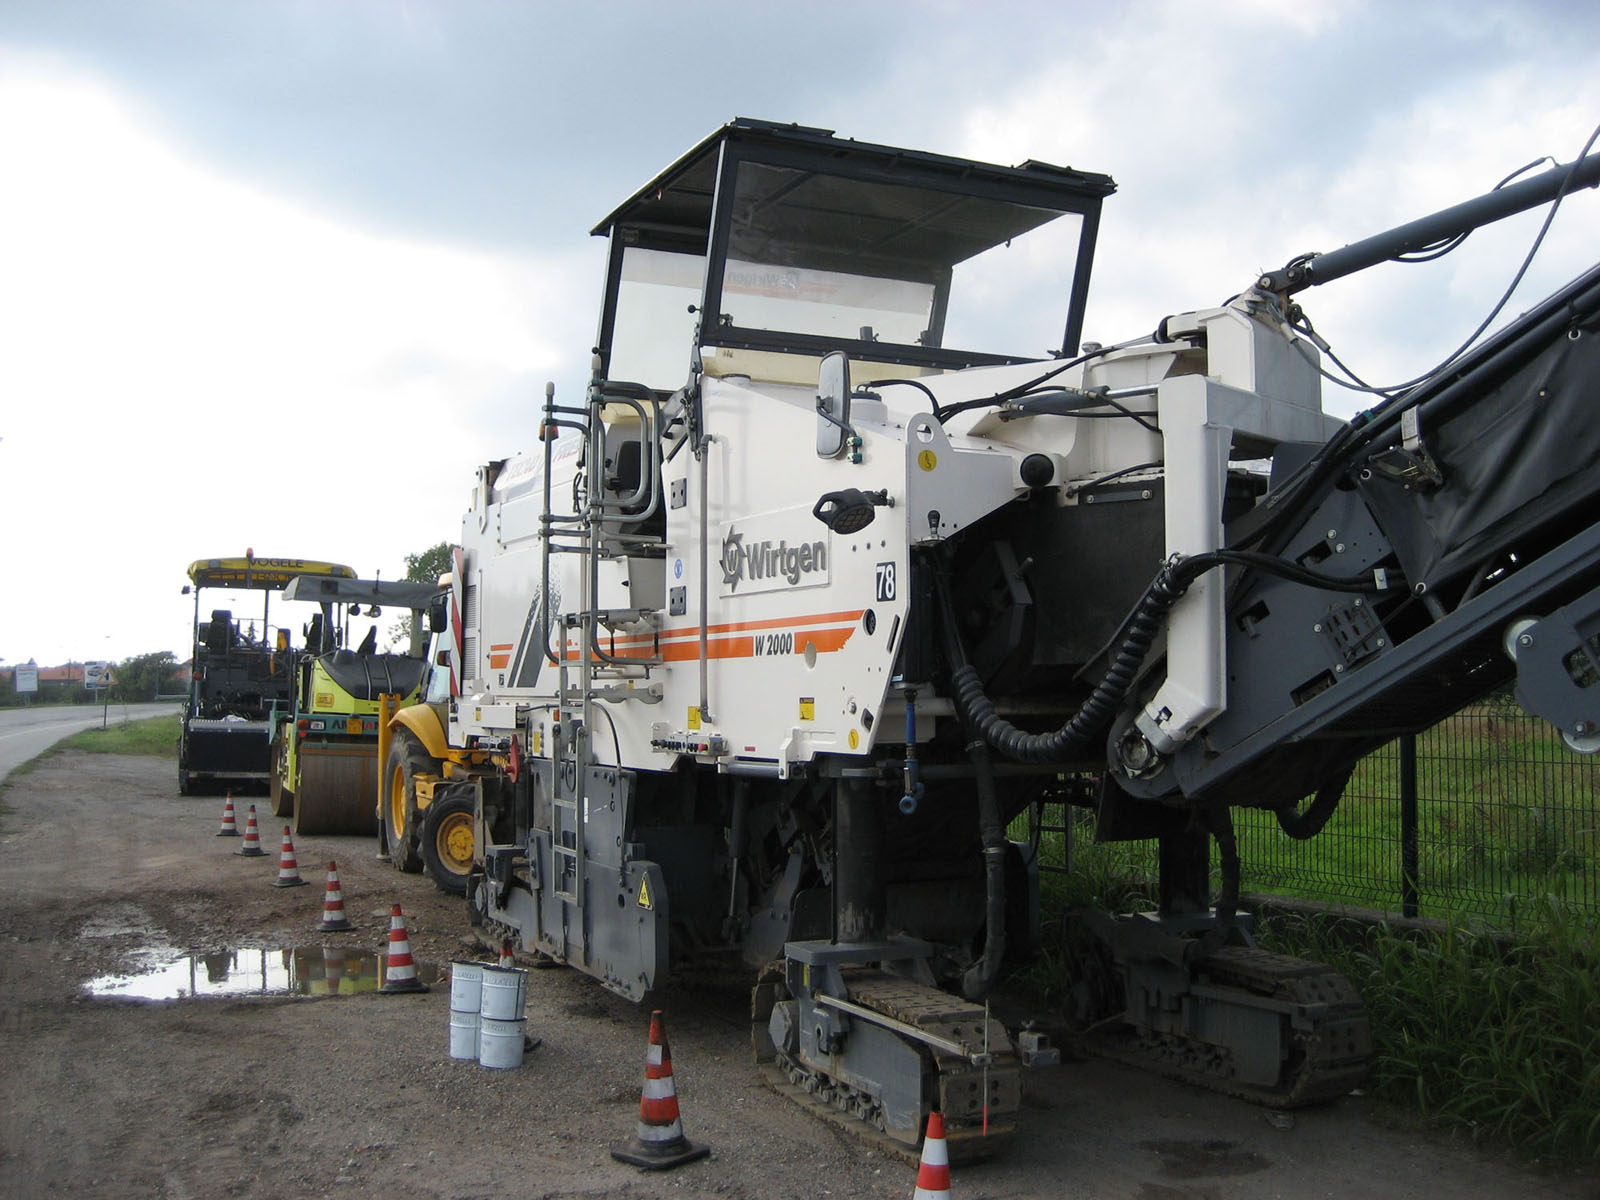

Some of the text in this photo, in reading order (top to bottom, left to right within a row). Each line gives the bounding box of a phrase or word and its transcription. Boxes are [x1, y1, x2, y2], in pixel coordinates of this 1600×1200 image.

[746, 540, 827, 585] Wirtgen
[877, 565, 895, 600] 78
[755, 633, 793, 656] W 2000
